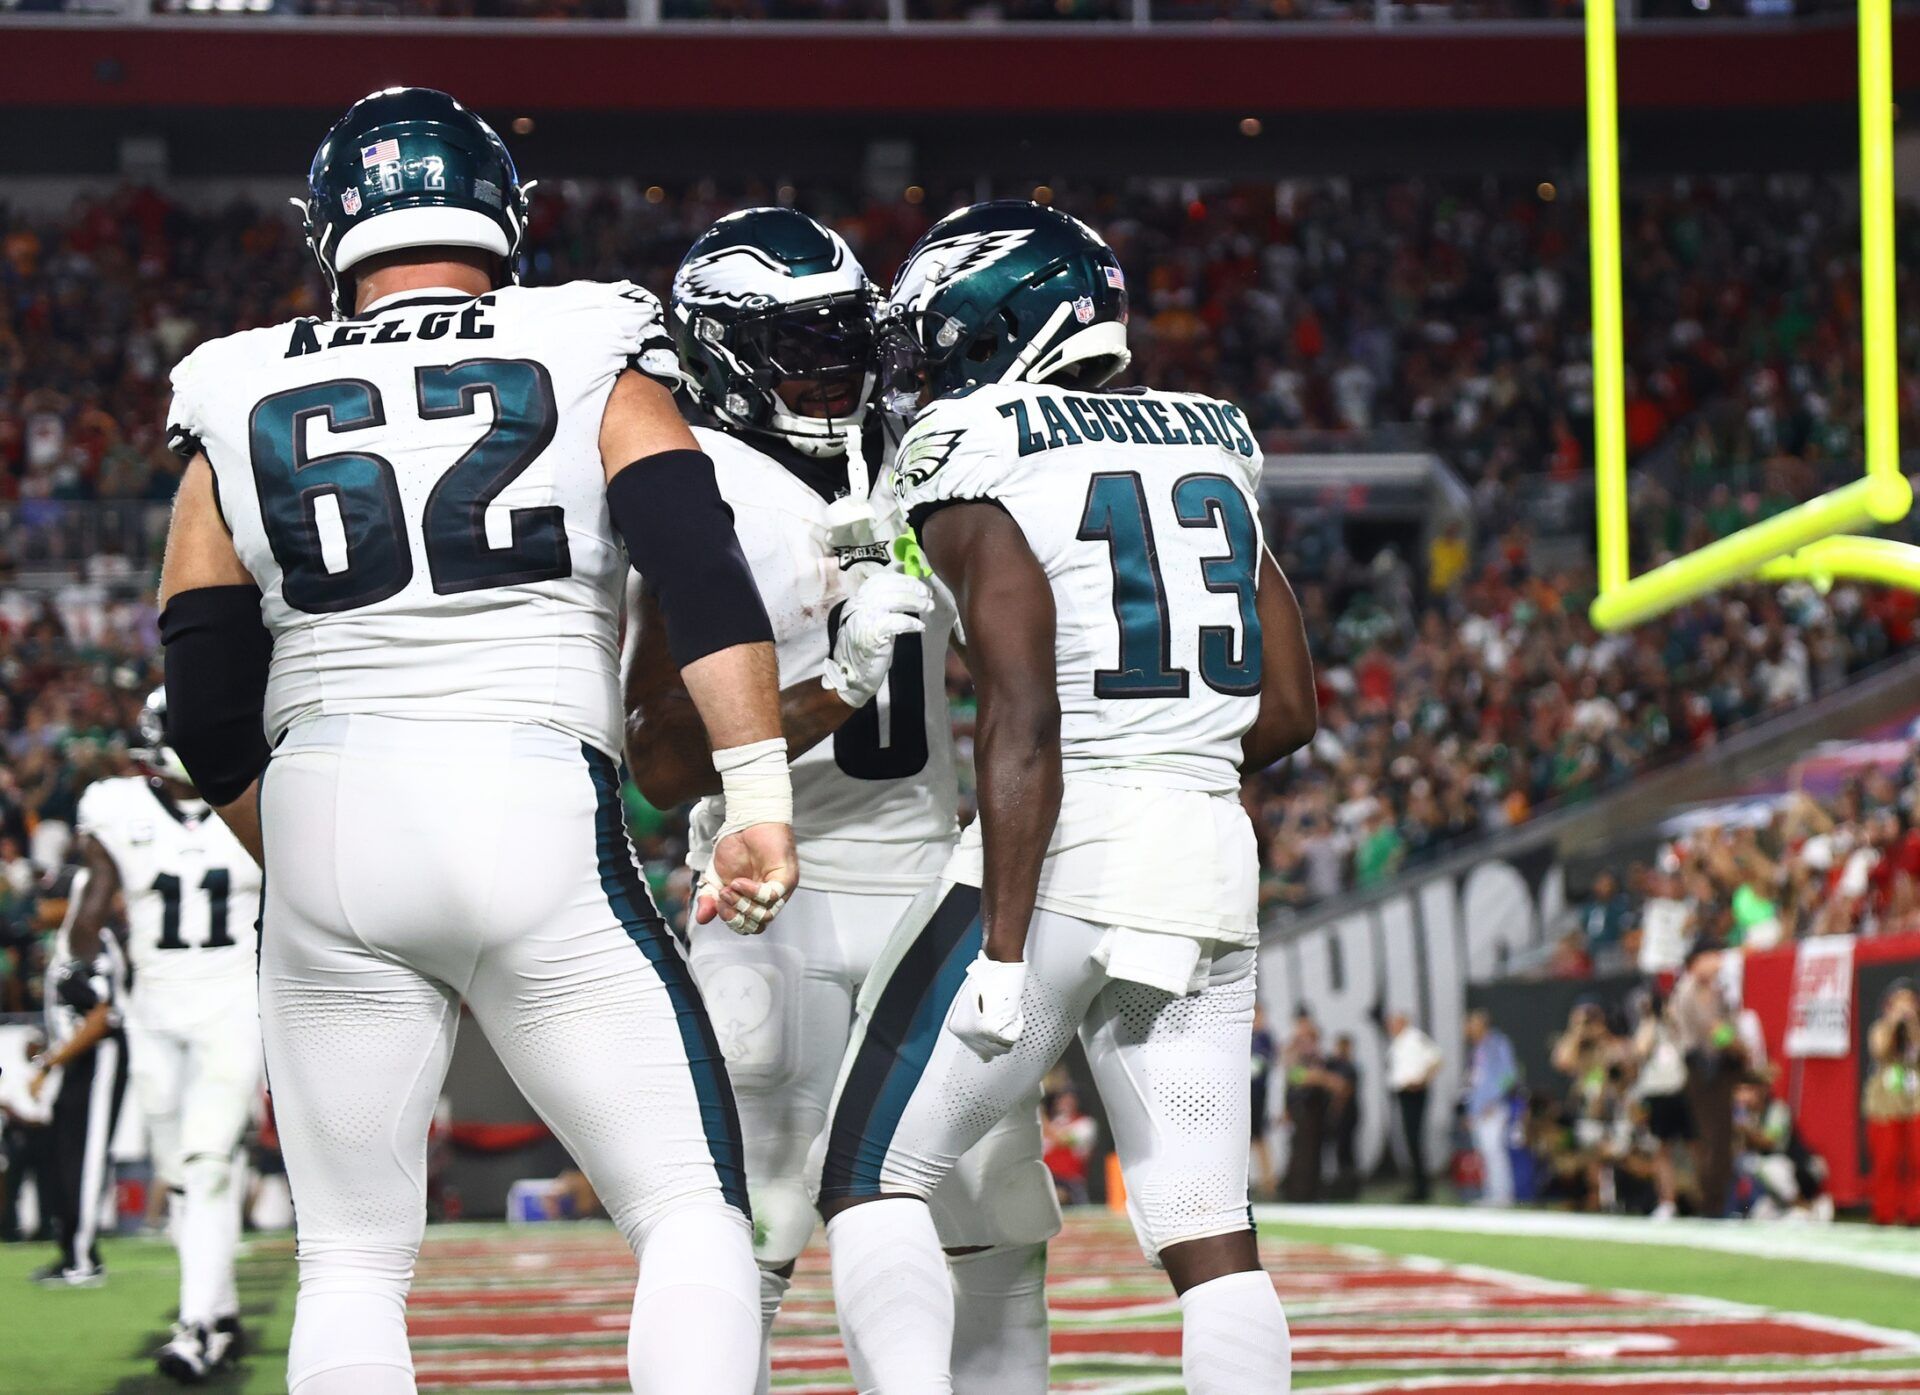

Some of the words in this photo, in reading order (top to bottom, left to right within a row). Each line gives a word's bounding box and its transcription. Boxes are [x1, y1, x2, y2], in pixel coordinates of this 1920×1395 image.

[996, 396, 1254, 458] ZACCHEAUS
[249, 357, 571, 614] 62
[839, 543, 889, 568] EAGLES
[1076, 470, 1263, 699] 13
[152, 868, 236, 949] 11
